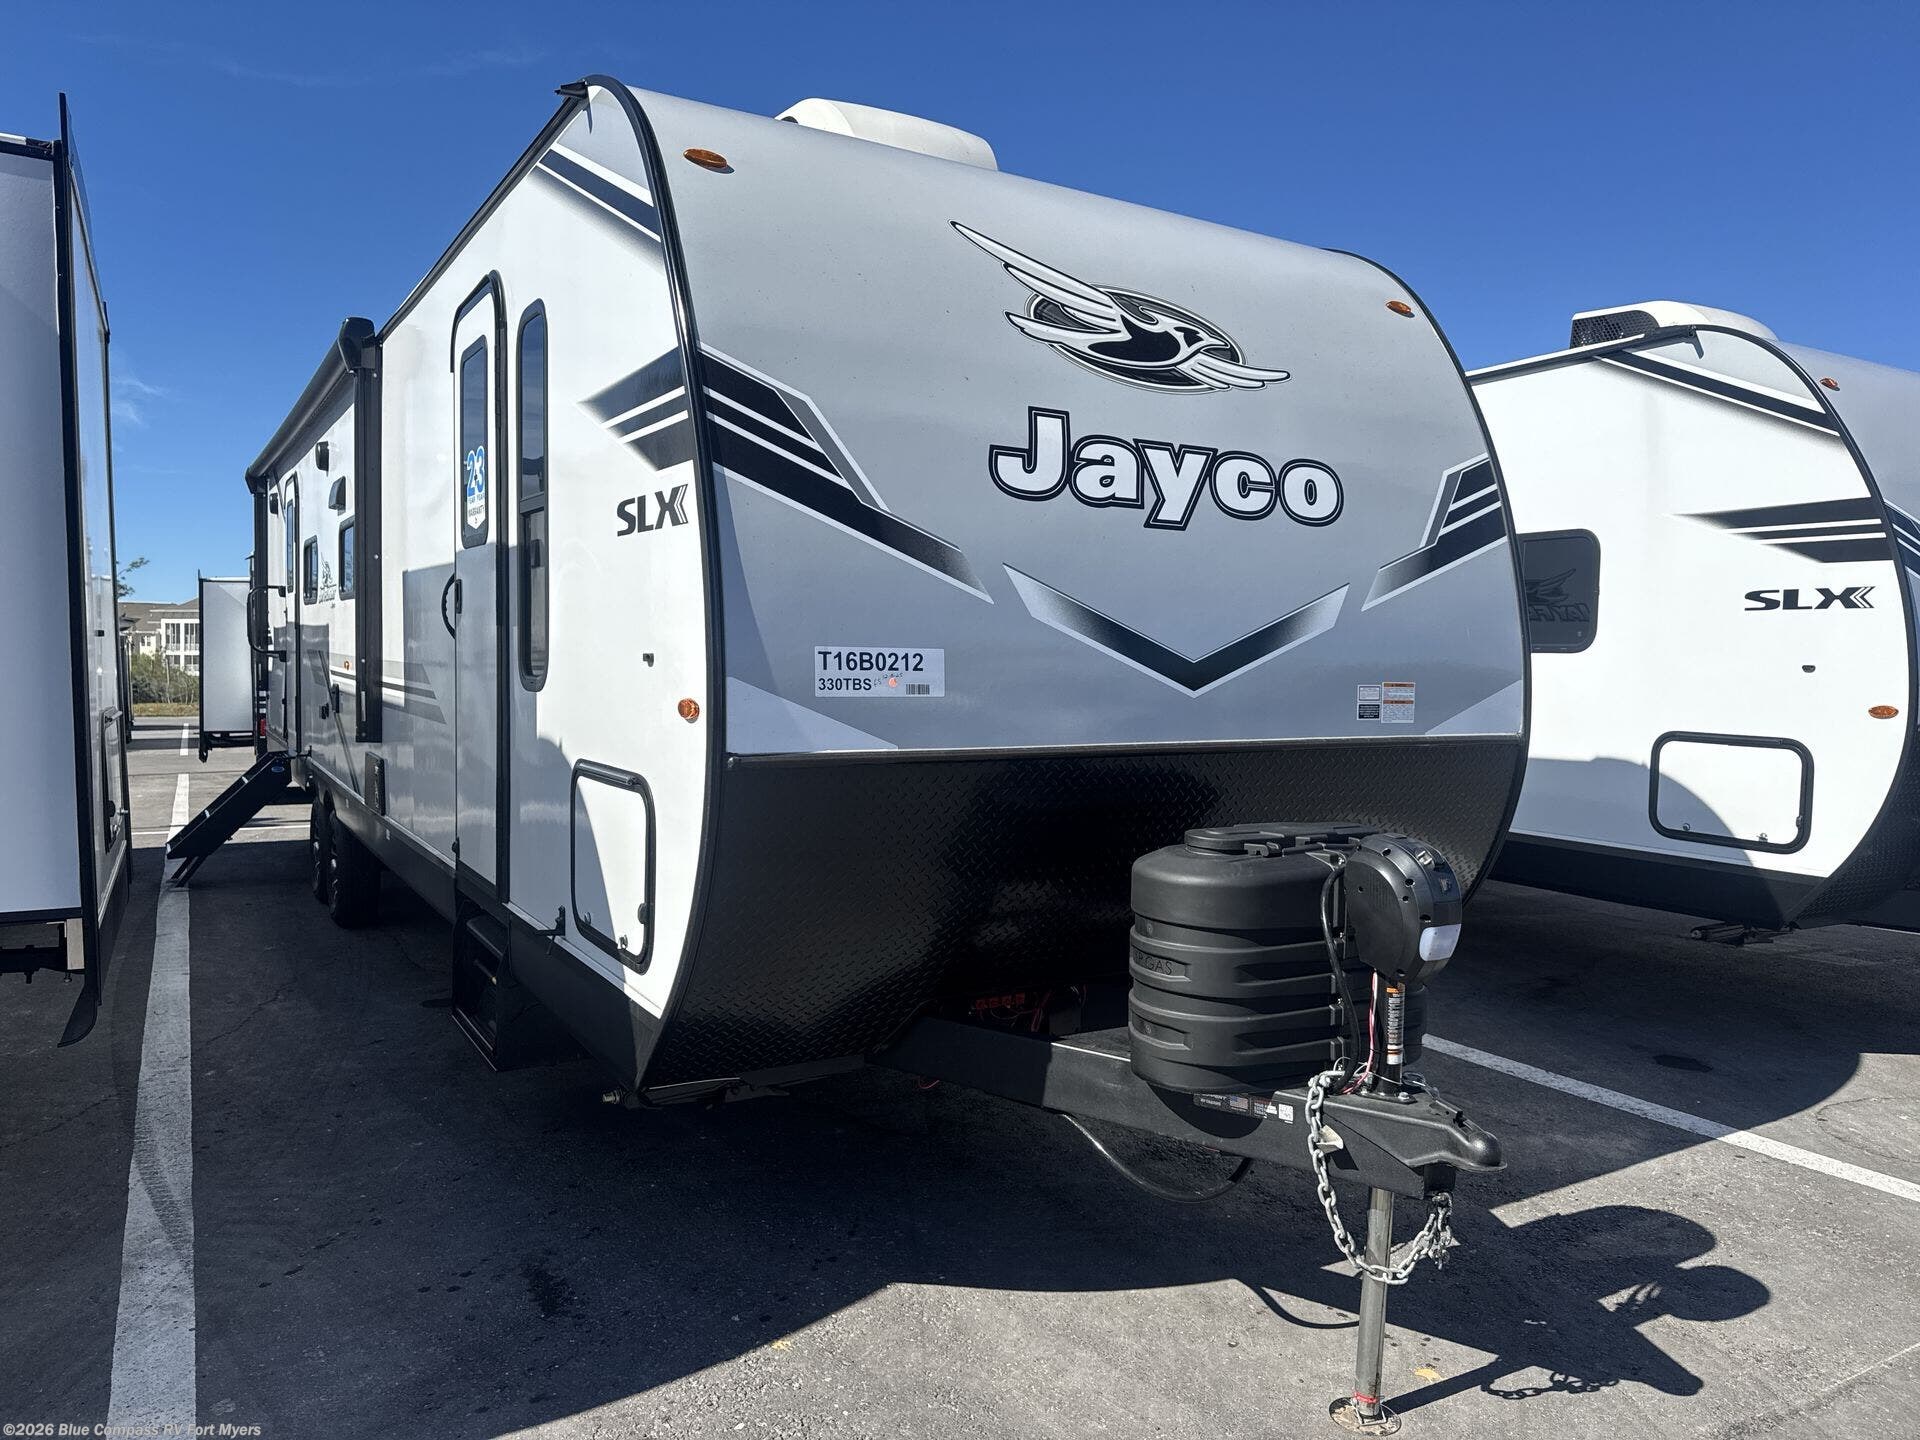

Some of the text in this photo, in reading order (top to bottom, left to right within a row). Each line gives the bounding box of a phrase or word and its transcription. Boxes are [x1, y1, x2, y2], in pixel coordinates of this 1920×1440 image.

[988, 406, 1344, 531] Jayco
[617, 484, 688, 537] SLX
[1744, 586, 1876, 611] SLX
[818, 651, 924, 671] T16B0212
[818, 678, 872, 691] 330TBS
